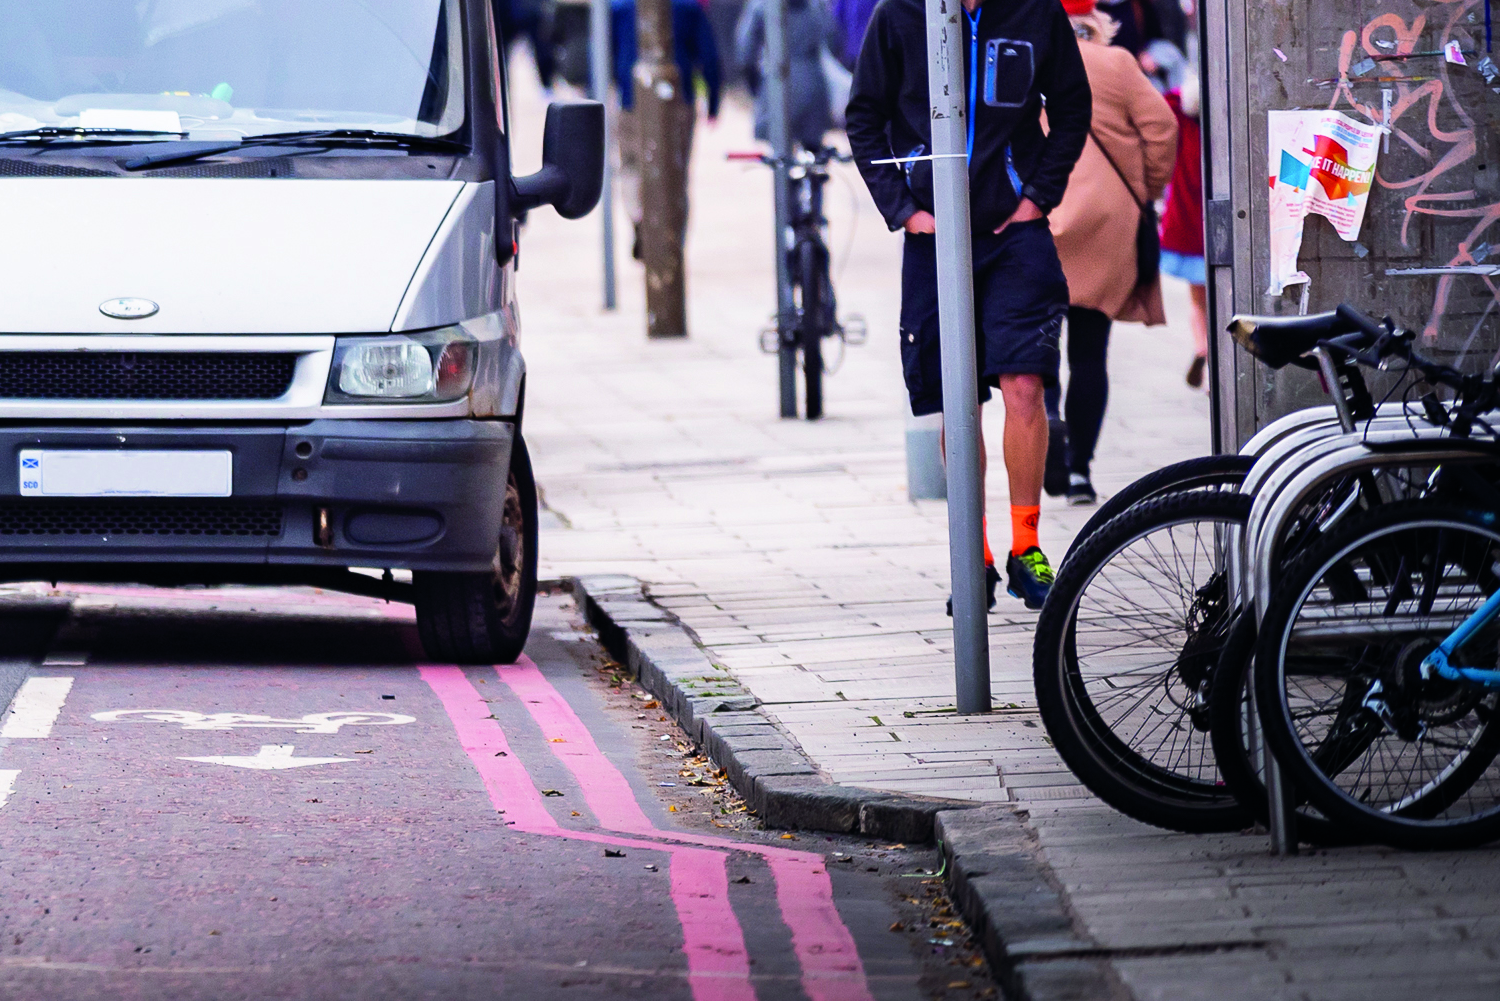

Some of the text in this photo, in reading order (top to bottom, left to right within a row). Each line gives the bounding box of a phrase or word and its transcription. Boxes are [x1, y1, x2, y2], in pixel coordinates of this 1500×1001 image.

[1322, 158, 1333, 172] IT
[1331, 162, 1372, 184] HAPPEN!
[23, 480, 39, 490] SCO
